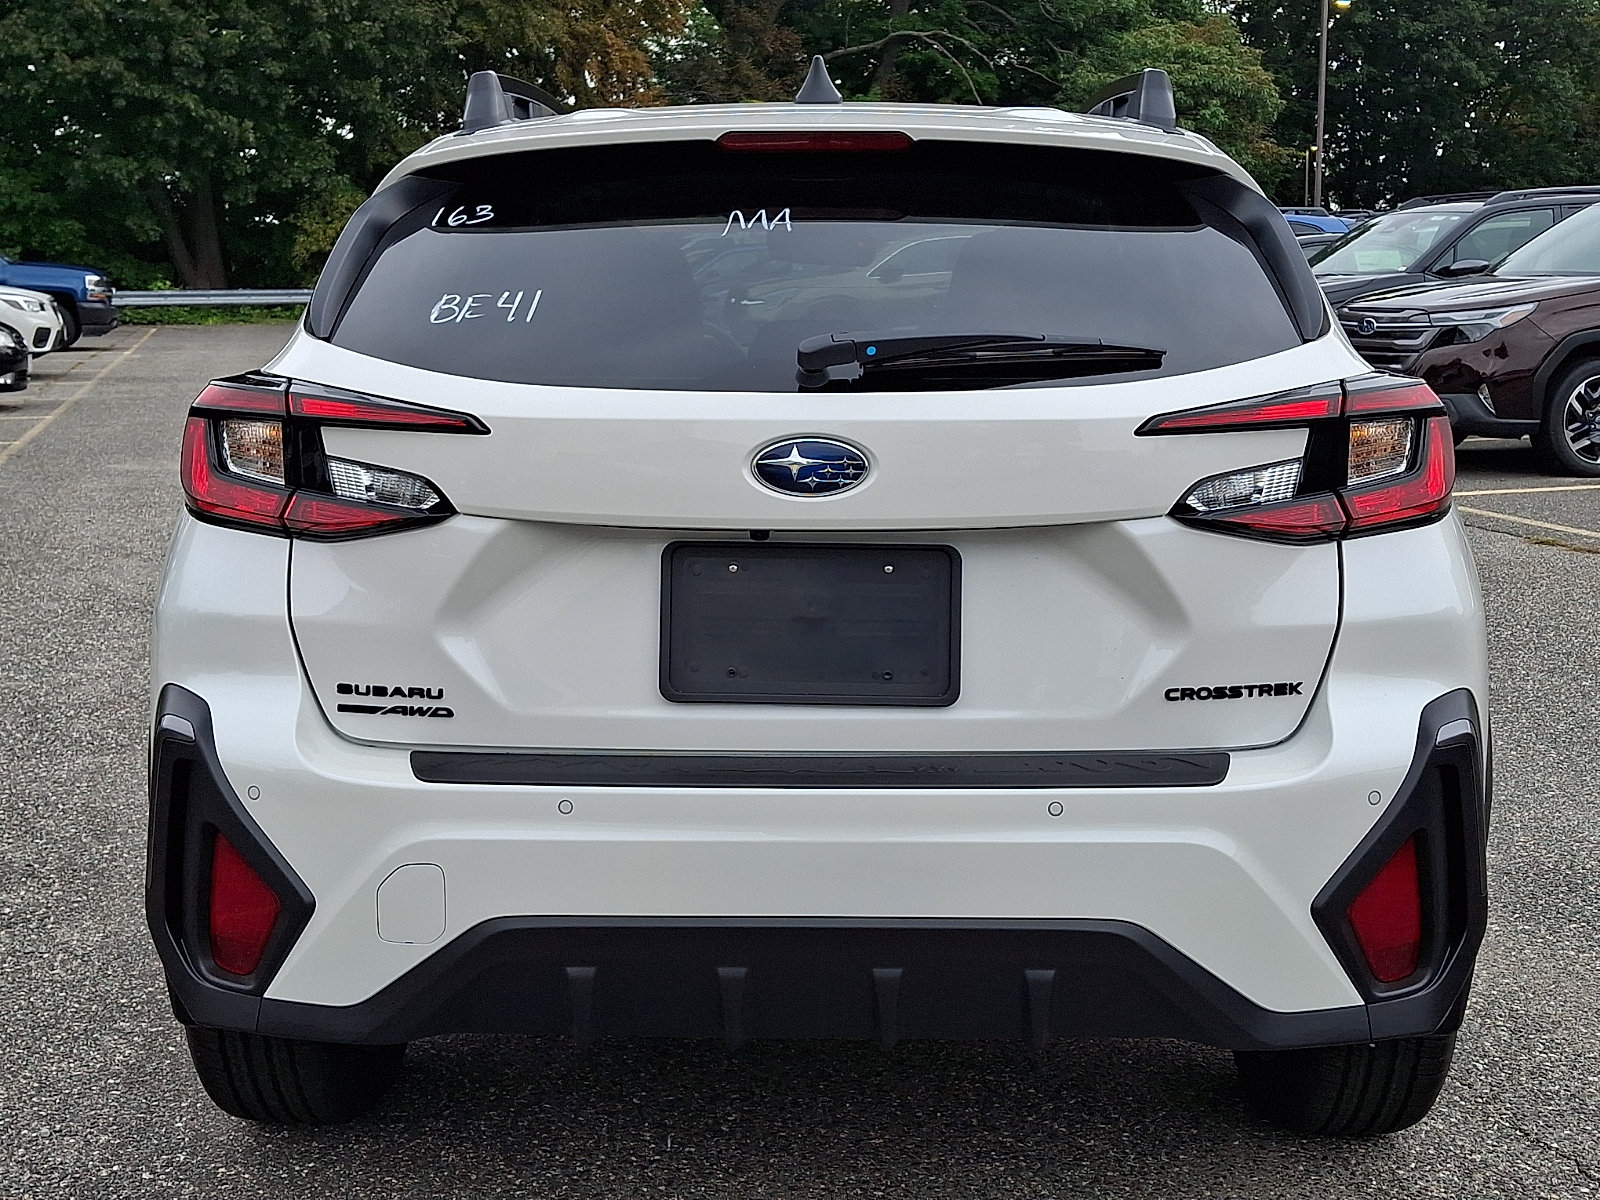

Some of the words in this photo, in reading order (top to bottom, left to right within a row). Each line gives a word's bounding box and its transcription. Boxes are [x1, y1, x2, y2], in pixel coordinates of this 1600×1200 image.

[431, 204, 495, 226] 163
[721, 207, 793, 237] MA
[336, 682, 444, 700] SUBARU
[1164, 681, 1304, 701] CROSSTREK
[379, 705, 455, 718] AWD
